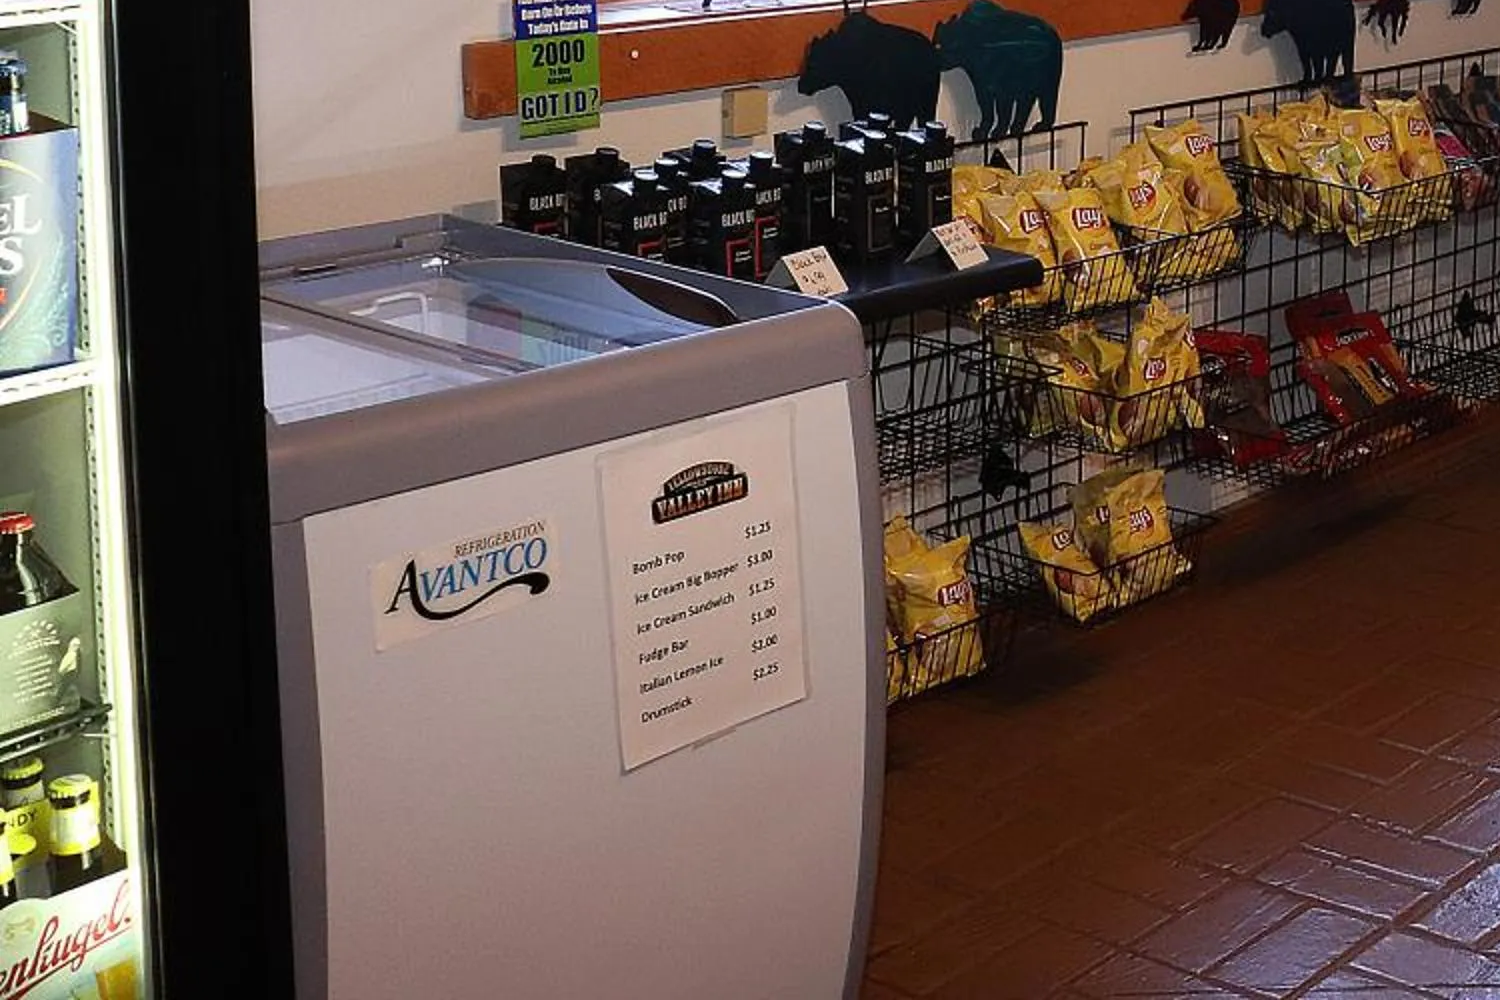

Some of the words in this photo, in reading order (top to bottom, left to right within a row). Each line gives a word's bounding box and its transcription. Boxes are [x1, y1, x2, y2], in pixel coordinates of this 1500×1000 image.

[532, 39, 585, 68] 2000
[522, 93, 560, 121] GOT
[656, 486, 714, 519] VALLEY
[716, 478, 743, 501] INN
[455, 521, 546, 557] REFRIGERATION
[632, 556, 663, 575] Bomb
[665, 551, 686, 567] Pop
[745, 521, 772, 539] $1.25
[384, 537, 549, 619] AVANTCO
[635, 592, 650, 606] Ice
[651, 581, 685, 600] Cream
[685, 574, 703, 588] Big
[636, 622, 651, 635] Ice
[653, 612, 687, 630] Cream
[688, 593, 735, 617] Sandwich
[639, 647, 669, 665] Fudge
[671, 639, 689, 654] Bar
[639, 674, 673, 694] Italian
[674, 661, 707, 681] Lemon
[709, 657, 724, 669] Ice
[641, 696, 693, 723] Drumstick
